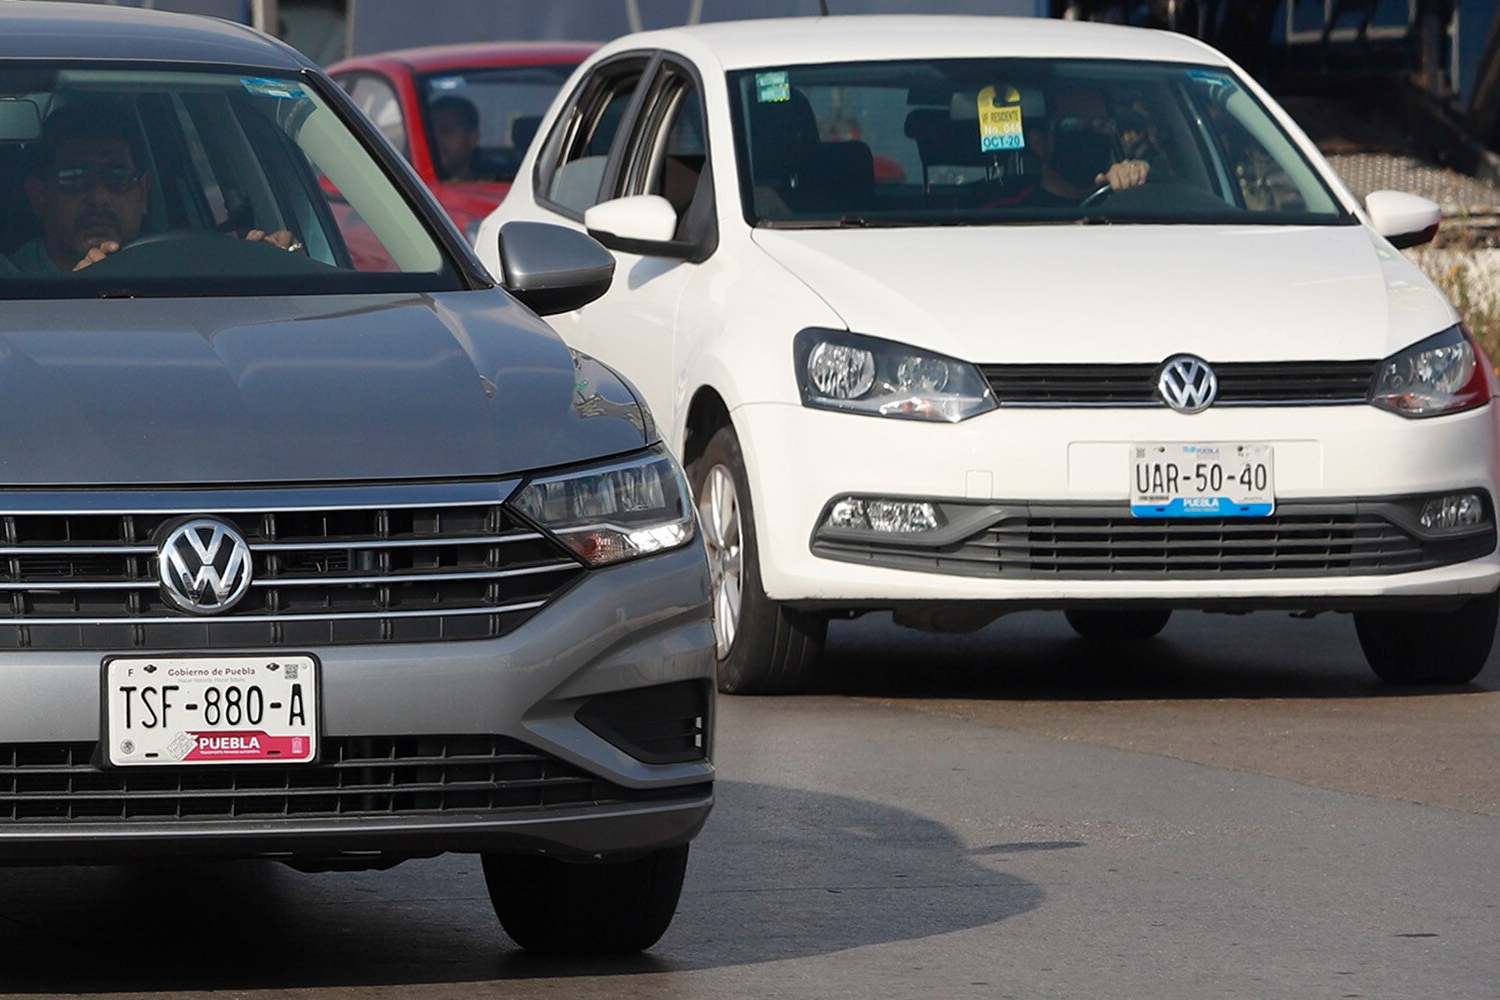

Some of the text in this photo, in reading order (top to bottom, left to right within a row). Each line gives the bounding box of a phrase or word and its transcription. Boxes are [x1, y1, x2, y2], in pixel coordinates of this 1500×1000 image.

[983, 135, 1020, 148] OCT-20
[1136, 463, 1267, 494] UAR-50-40
[1183, 498, 1220, 507] PUEBLA
[168, 667, 256, 676] Gobierno de Puebla
[119, 683, 306, 729] TSF-880-A
[199, 737, 260, 750] PUEBLA
